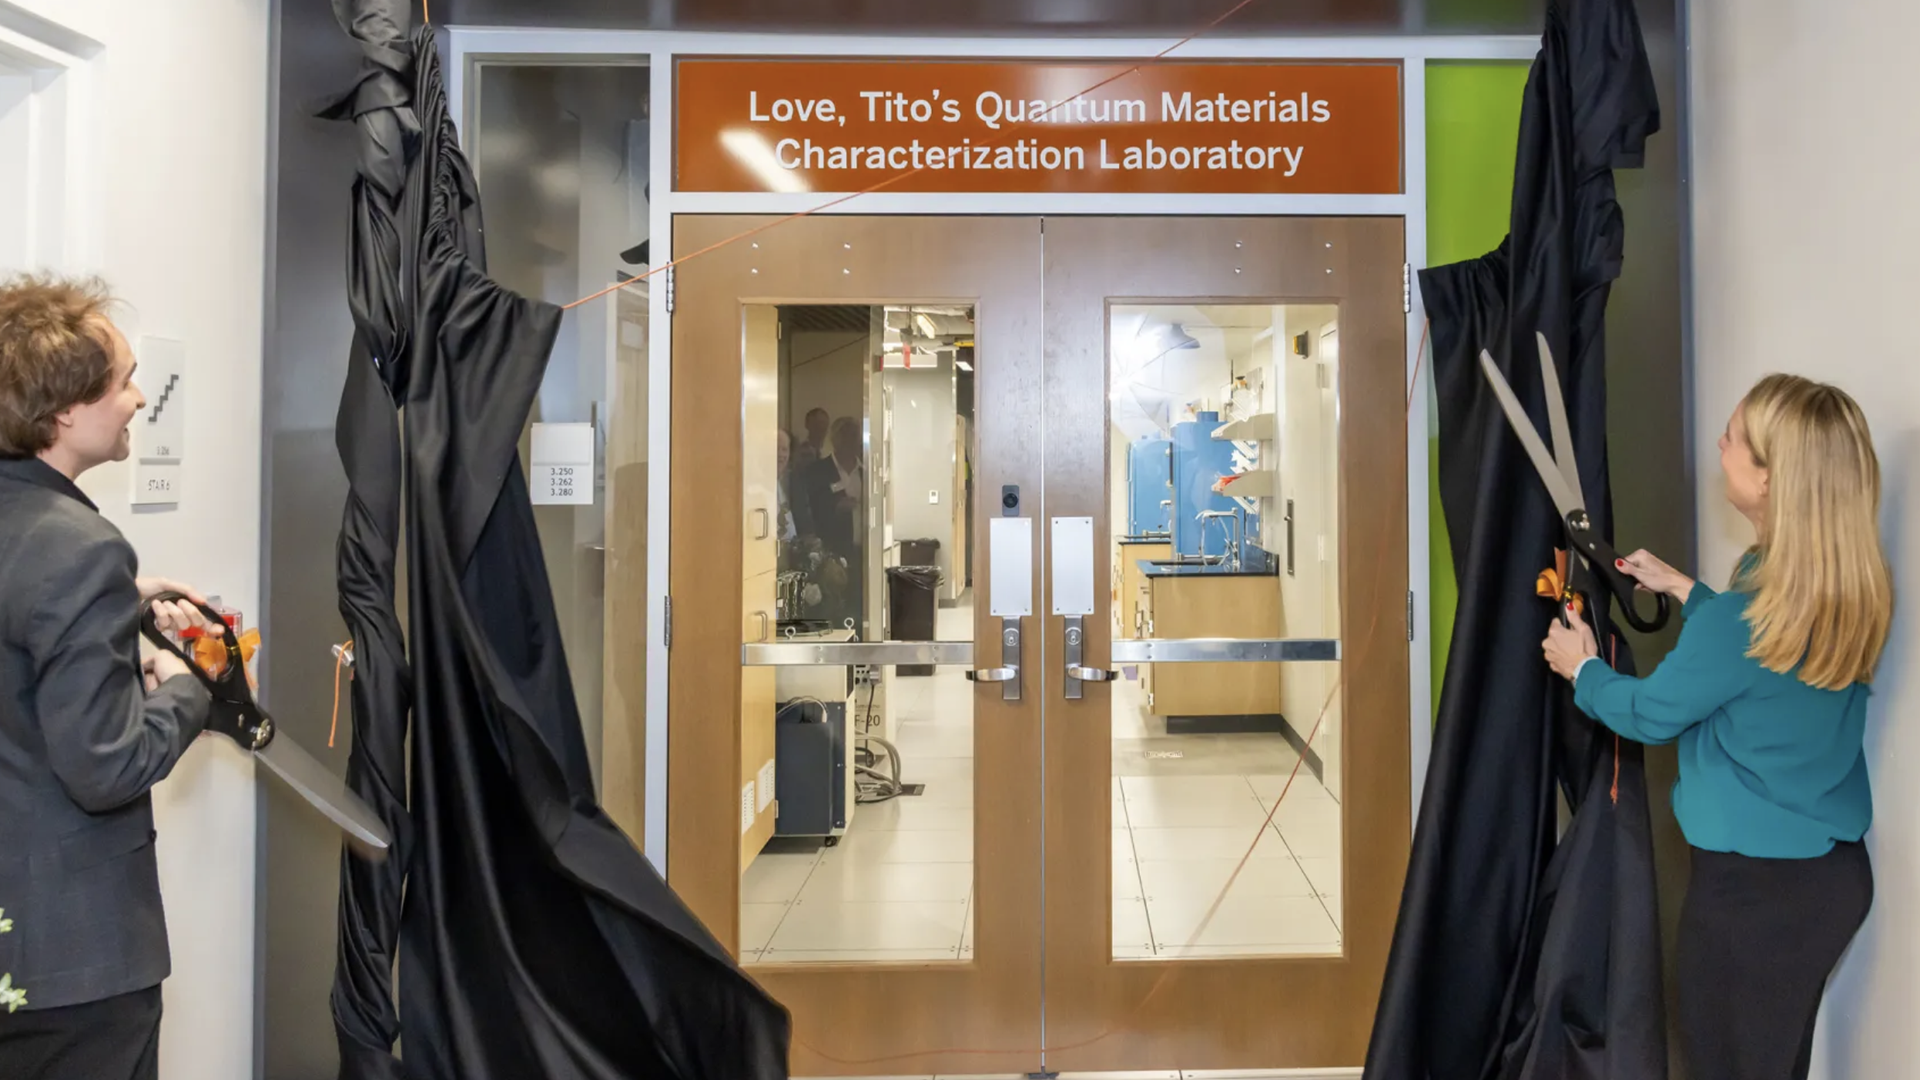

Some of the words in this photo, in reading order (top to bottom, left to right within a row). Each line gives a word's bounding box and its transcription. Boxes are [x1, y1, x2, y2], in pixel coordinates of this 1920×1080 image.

[749, 90, 846, 127] Love,
[859, 89, 961, 122] Tito’s
[975, 91, 1145, 129] Quantum
[1161, 91, 1331, 123] Materials
[775, 138, 1084, 170] Characterization
[1100, 138, 1304, 177] Laboratory
[551, 468, 573, 476] 3.250
[550, 477, 573, 487] 3.262
[551, 488, 573, 496] 3.280
